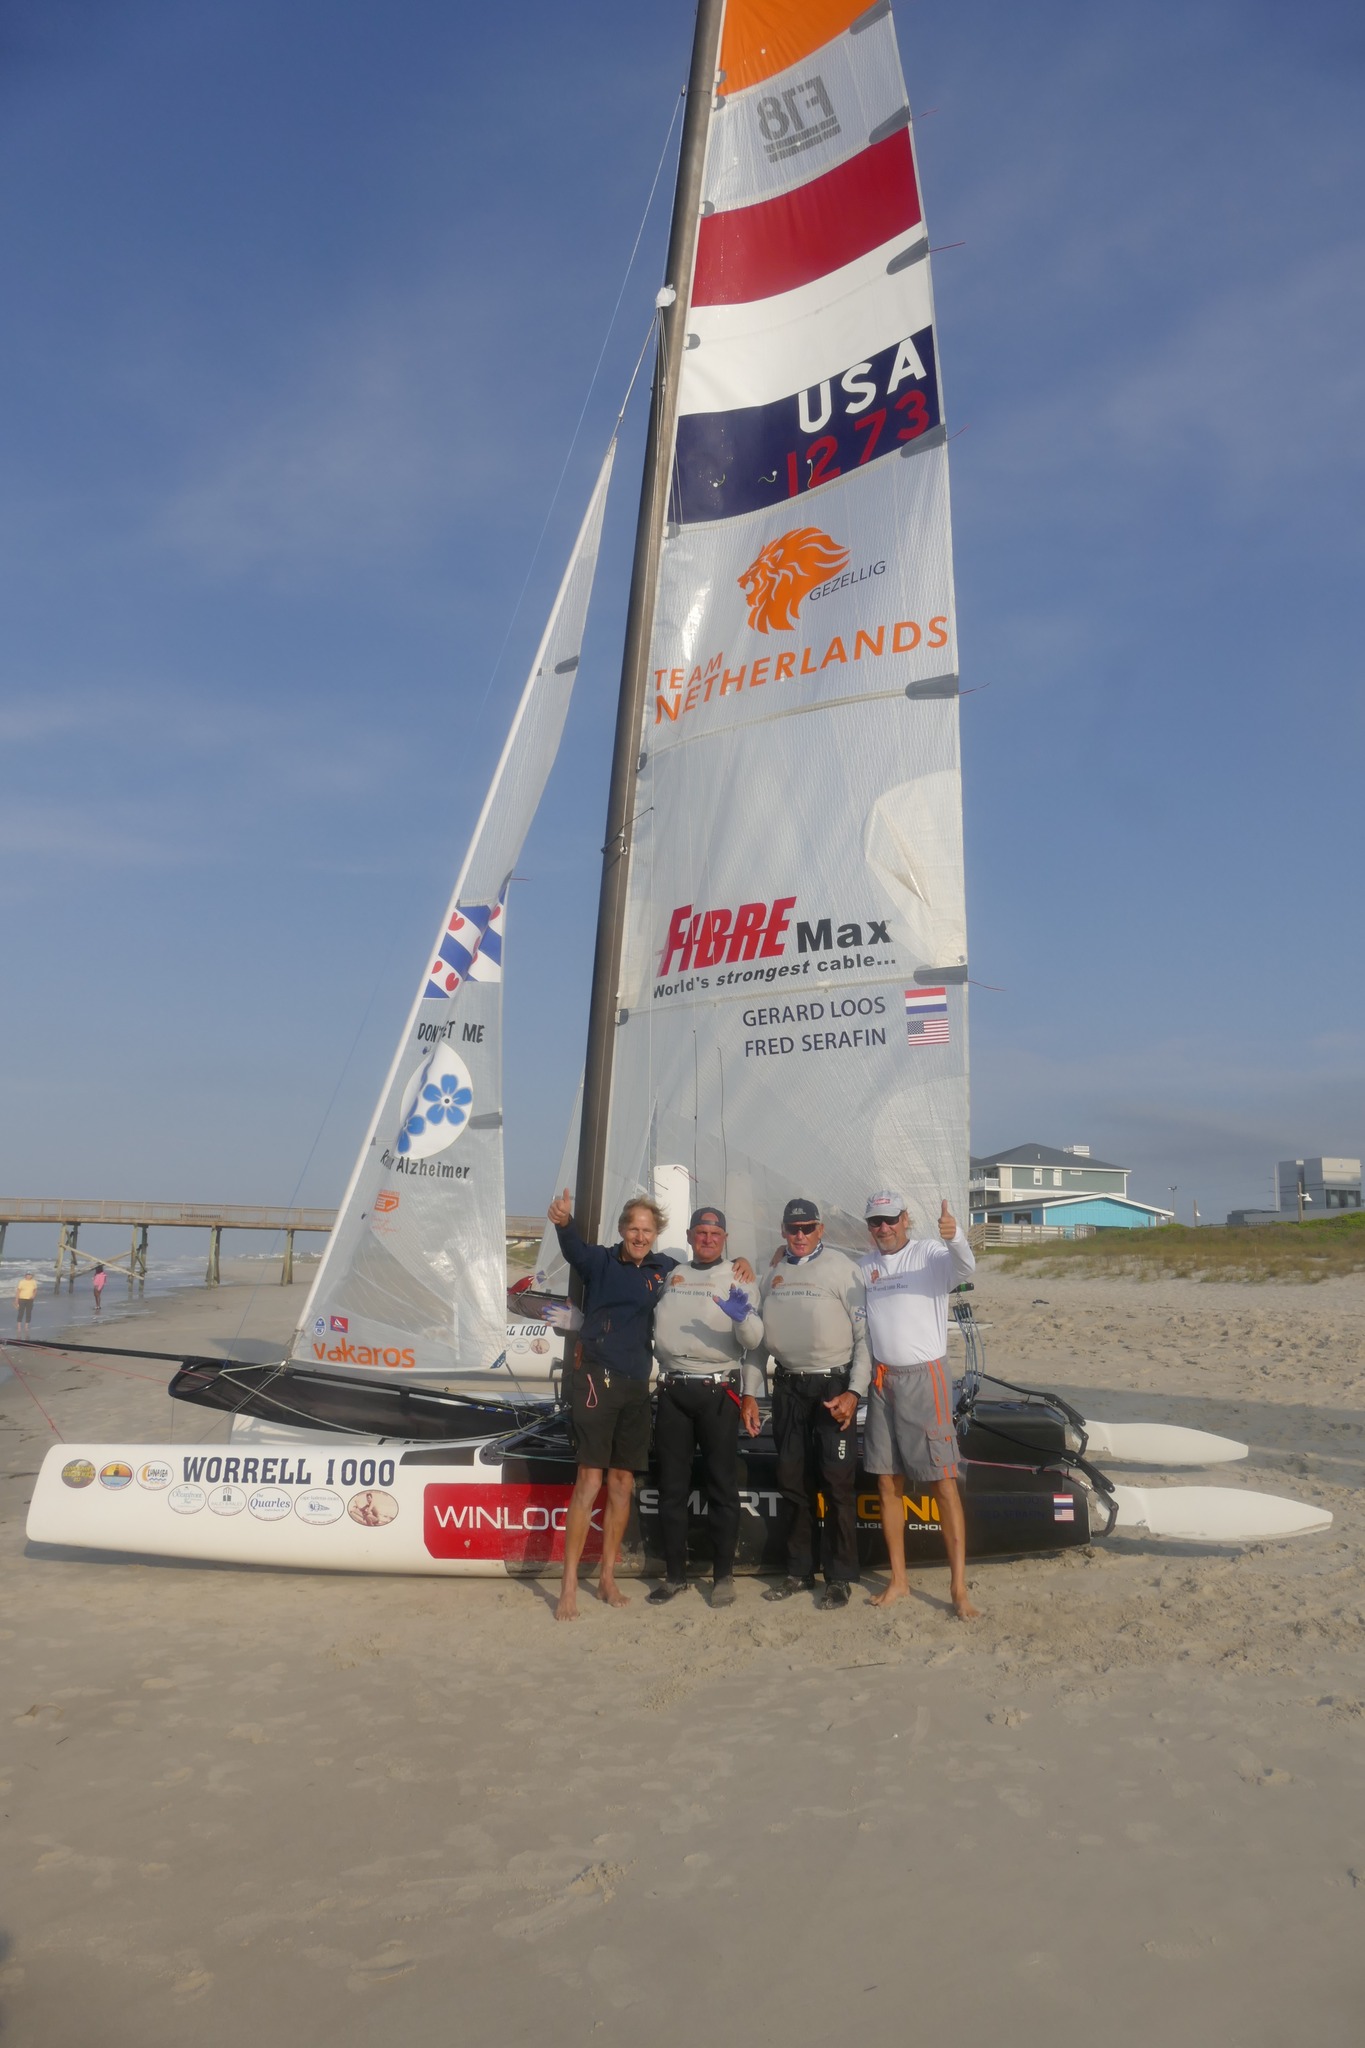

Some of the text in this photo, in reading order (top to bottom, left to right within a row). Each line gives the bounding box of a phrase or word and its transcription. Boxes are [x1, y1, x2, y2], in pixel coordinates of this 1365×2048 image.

[798, 337, 927, 433] USA
[787, 390, 930, 498] 1273
[809, 560, 886, 601] GEZELLIG
[654, 616, 948, 725] NETHERLANDS
[654, 652, 723, 691] TEAM
[796, 918, 893, 953] Max
[653, 953, 896, 999] World's strongest cable...
[742, 996, 887, 1027] GERARD LOOS
[462, 1022, 485, 1043] ME
[745, 1027, 887, 1058] FRED SERAFIN
[396, 1156, 470, 1179] Alzheimer
[520, 1325, 548, 1337] 1000
[183, 1456, 395, 1487] WORRELL 1000
[250, 1498, 291, 1510] Quarles
